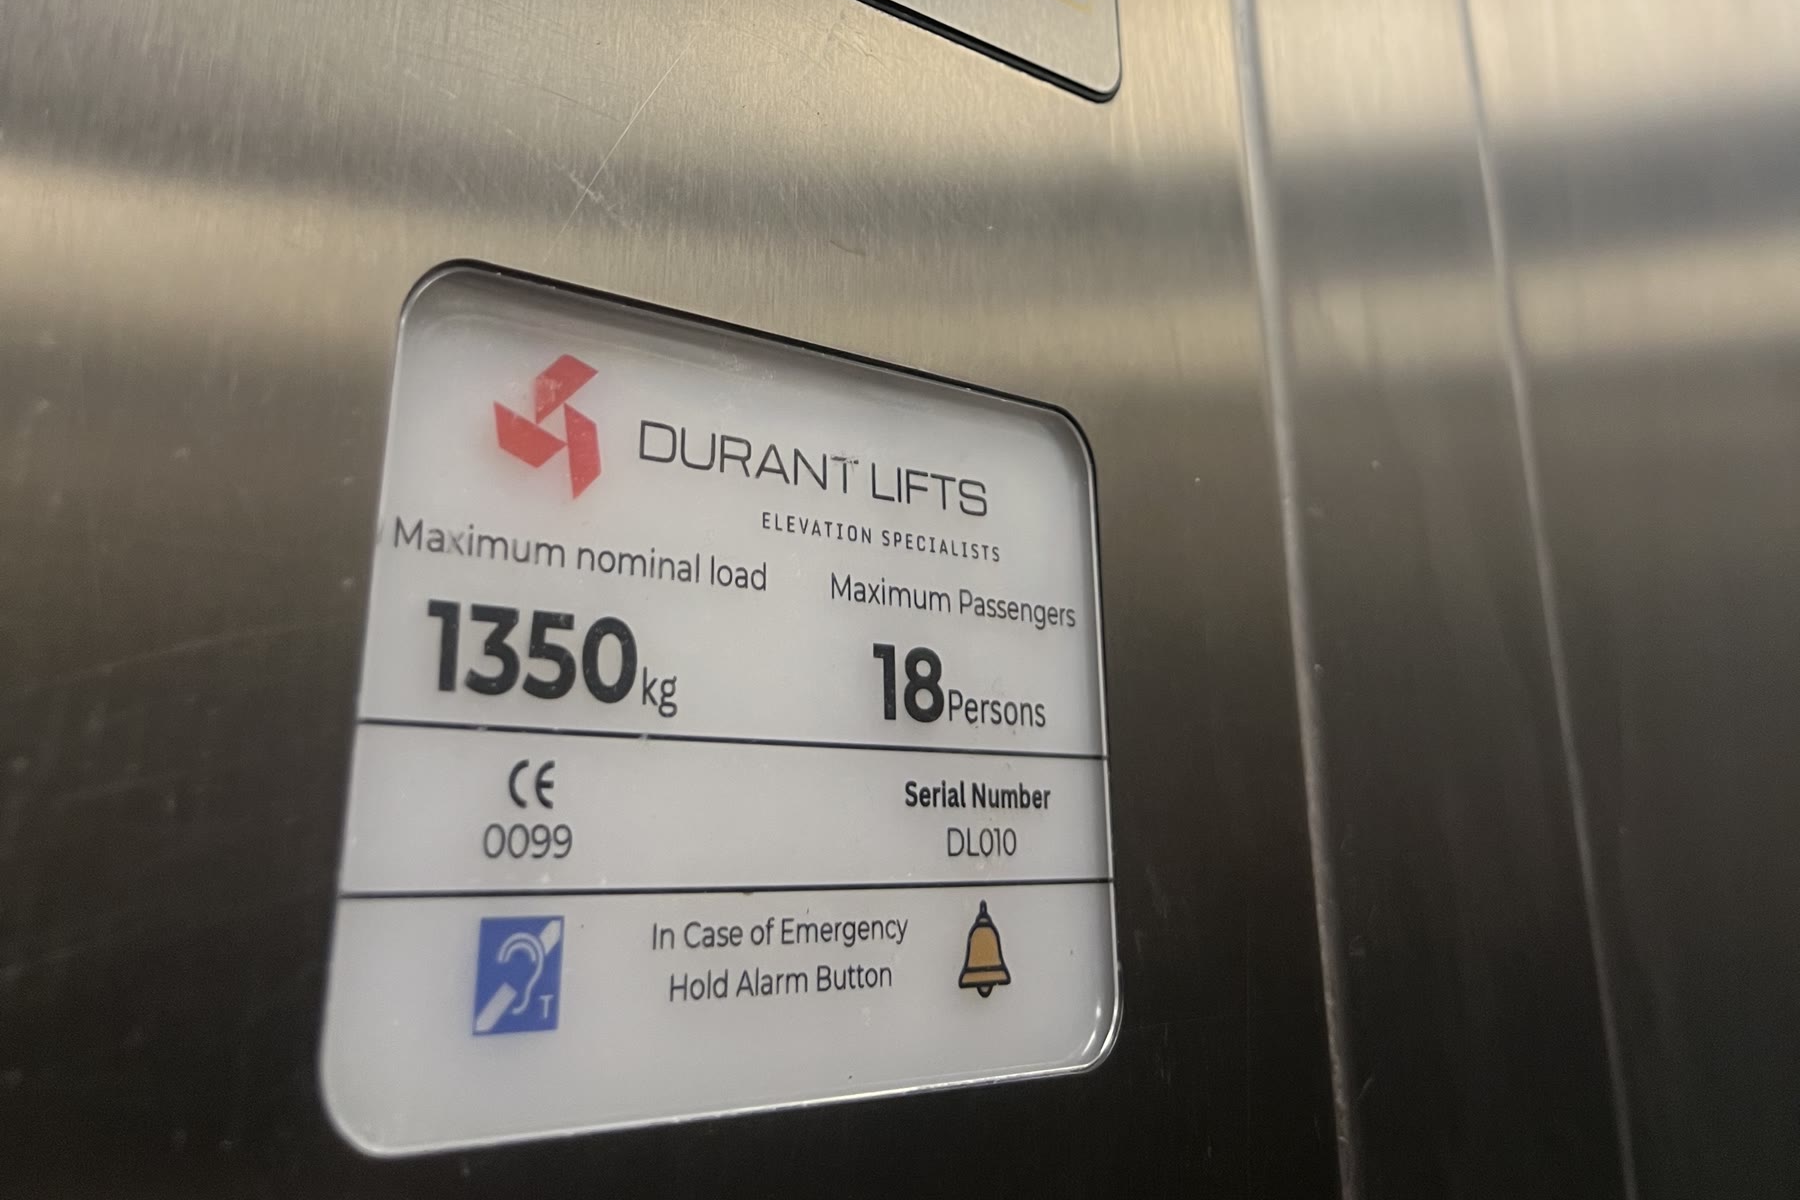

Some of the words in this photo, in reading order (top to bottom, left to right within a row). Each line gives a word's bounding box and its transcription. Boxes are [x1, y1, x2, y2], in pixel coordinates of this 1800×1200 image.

[639, 420, 860, 494] DURANT
[871, 462, 988, 517] LIFTS
[393, 516, 566, 568] Maximum
[577, 547, 700, 583] nominal
[710, 555, 768, 591] load
[762, 511, 872, 544] ELEVATION
[881, 530, 1001, 562] SPECIALISTS
[831, 572, 951, 612] Maximum
[959, 589, 1076, 630] Passengers
[427, 599, 638, 704] 1350
[641, 666, 678, 718] kg
[873, 643, 945, 723] 18
[948, 689, 1046, 728] Persons
[905, 780, 966, 808] Serial
[972, 782, 1051, 809] Number
[483, 823, 573, 859] 0099
[947, 827, 1017, 857] DL010
[652, 923, 675, 950] In
[683, 920, 743, 949] Case
[750, 917, 773, 946] of
[780, 915, 909, 948] Emergency
[669, 969, 728, 1002] Hold
[736, 966, 809, 997] Alarm
[816, 963, 893, 993] Button
